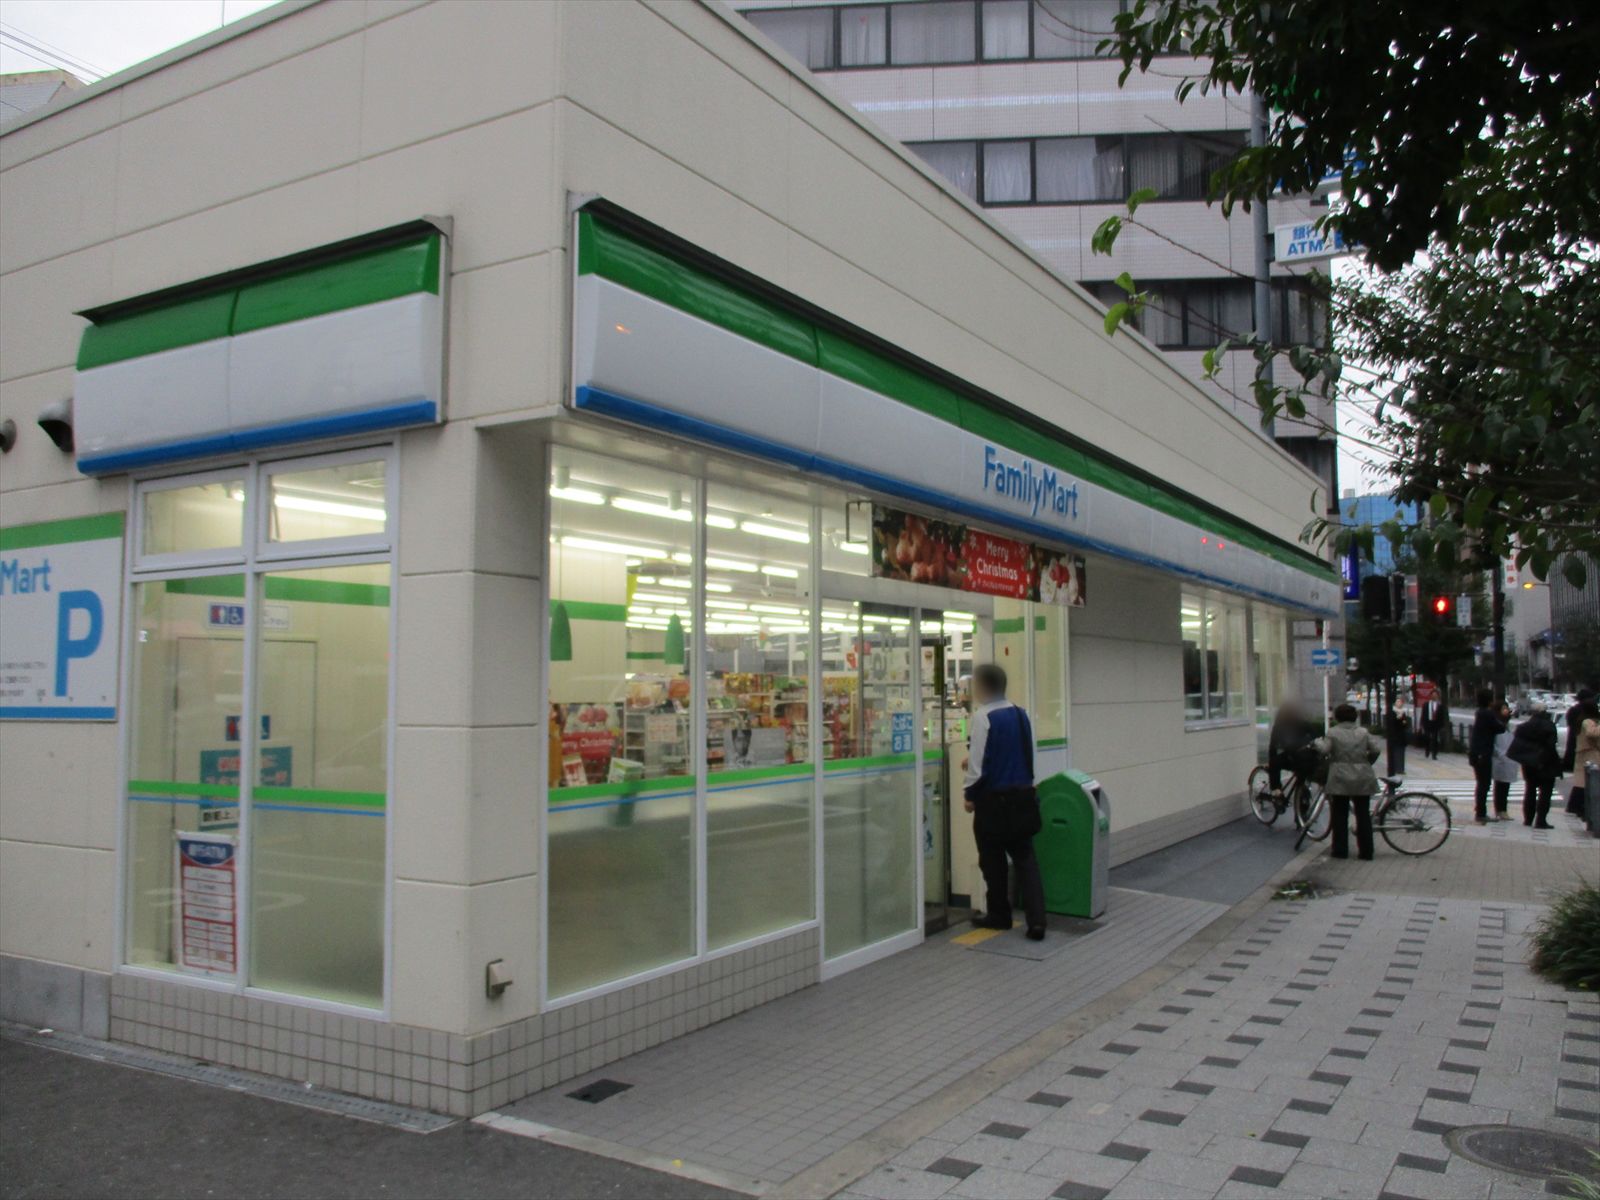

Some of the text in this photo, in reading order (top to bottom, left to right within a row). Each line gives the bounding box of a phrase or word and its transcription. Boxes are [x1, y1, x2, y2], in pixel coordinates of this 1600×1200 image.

[1288, 241, 1323, 256] ATM
[984, 445, 1078, 519] FamilyMart
[986, 540, 1009, 562] Merry
[976, 558, 1018, 581] Christmas
[55, 590, 103, 696] P
